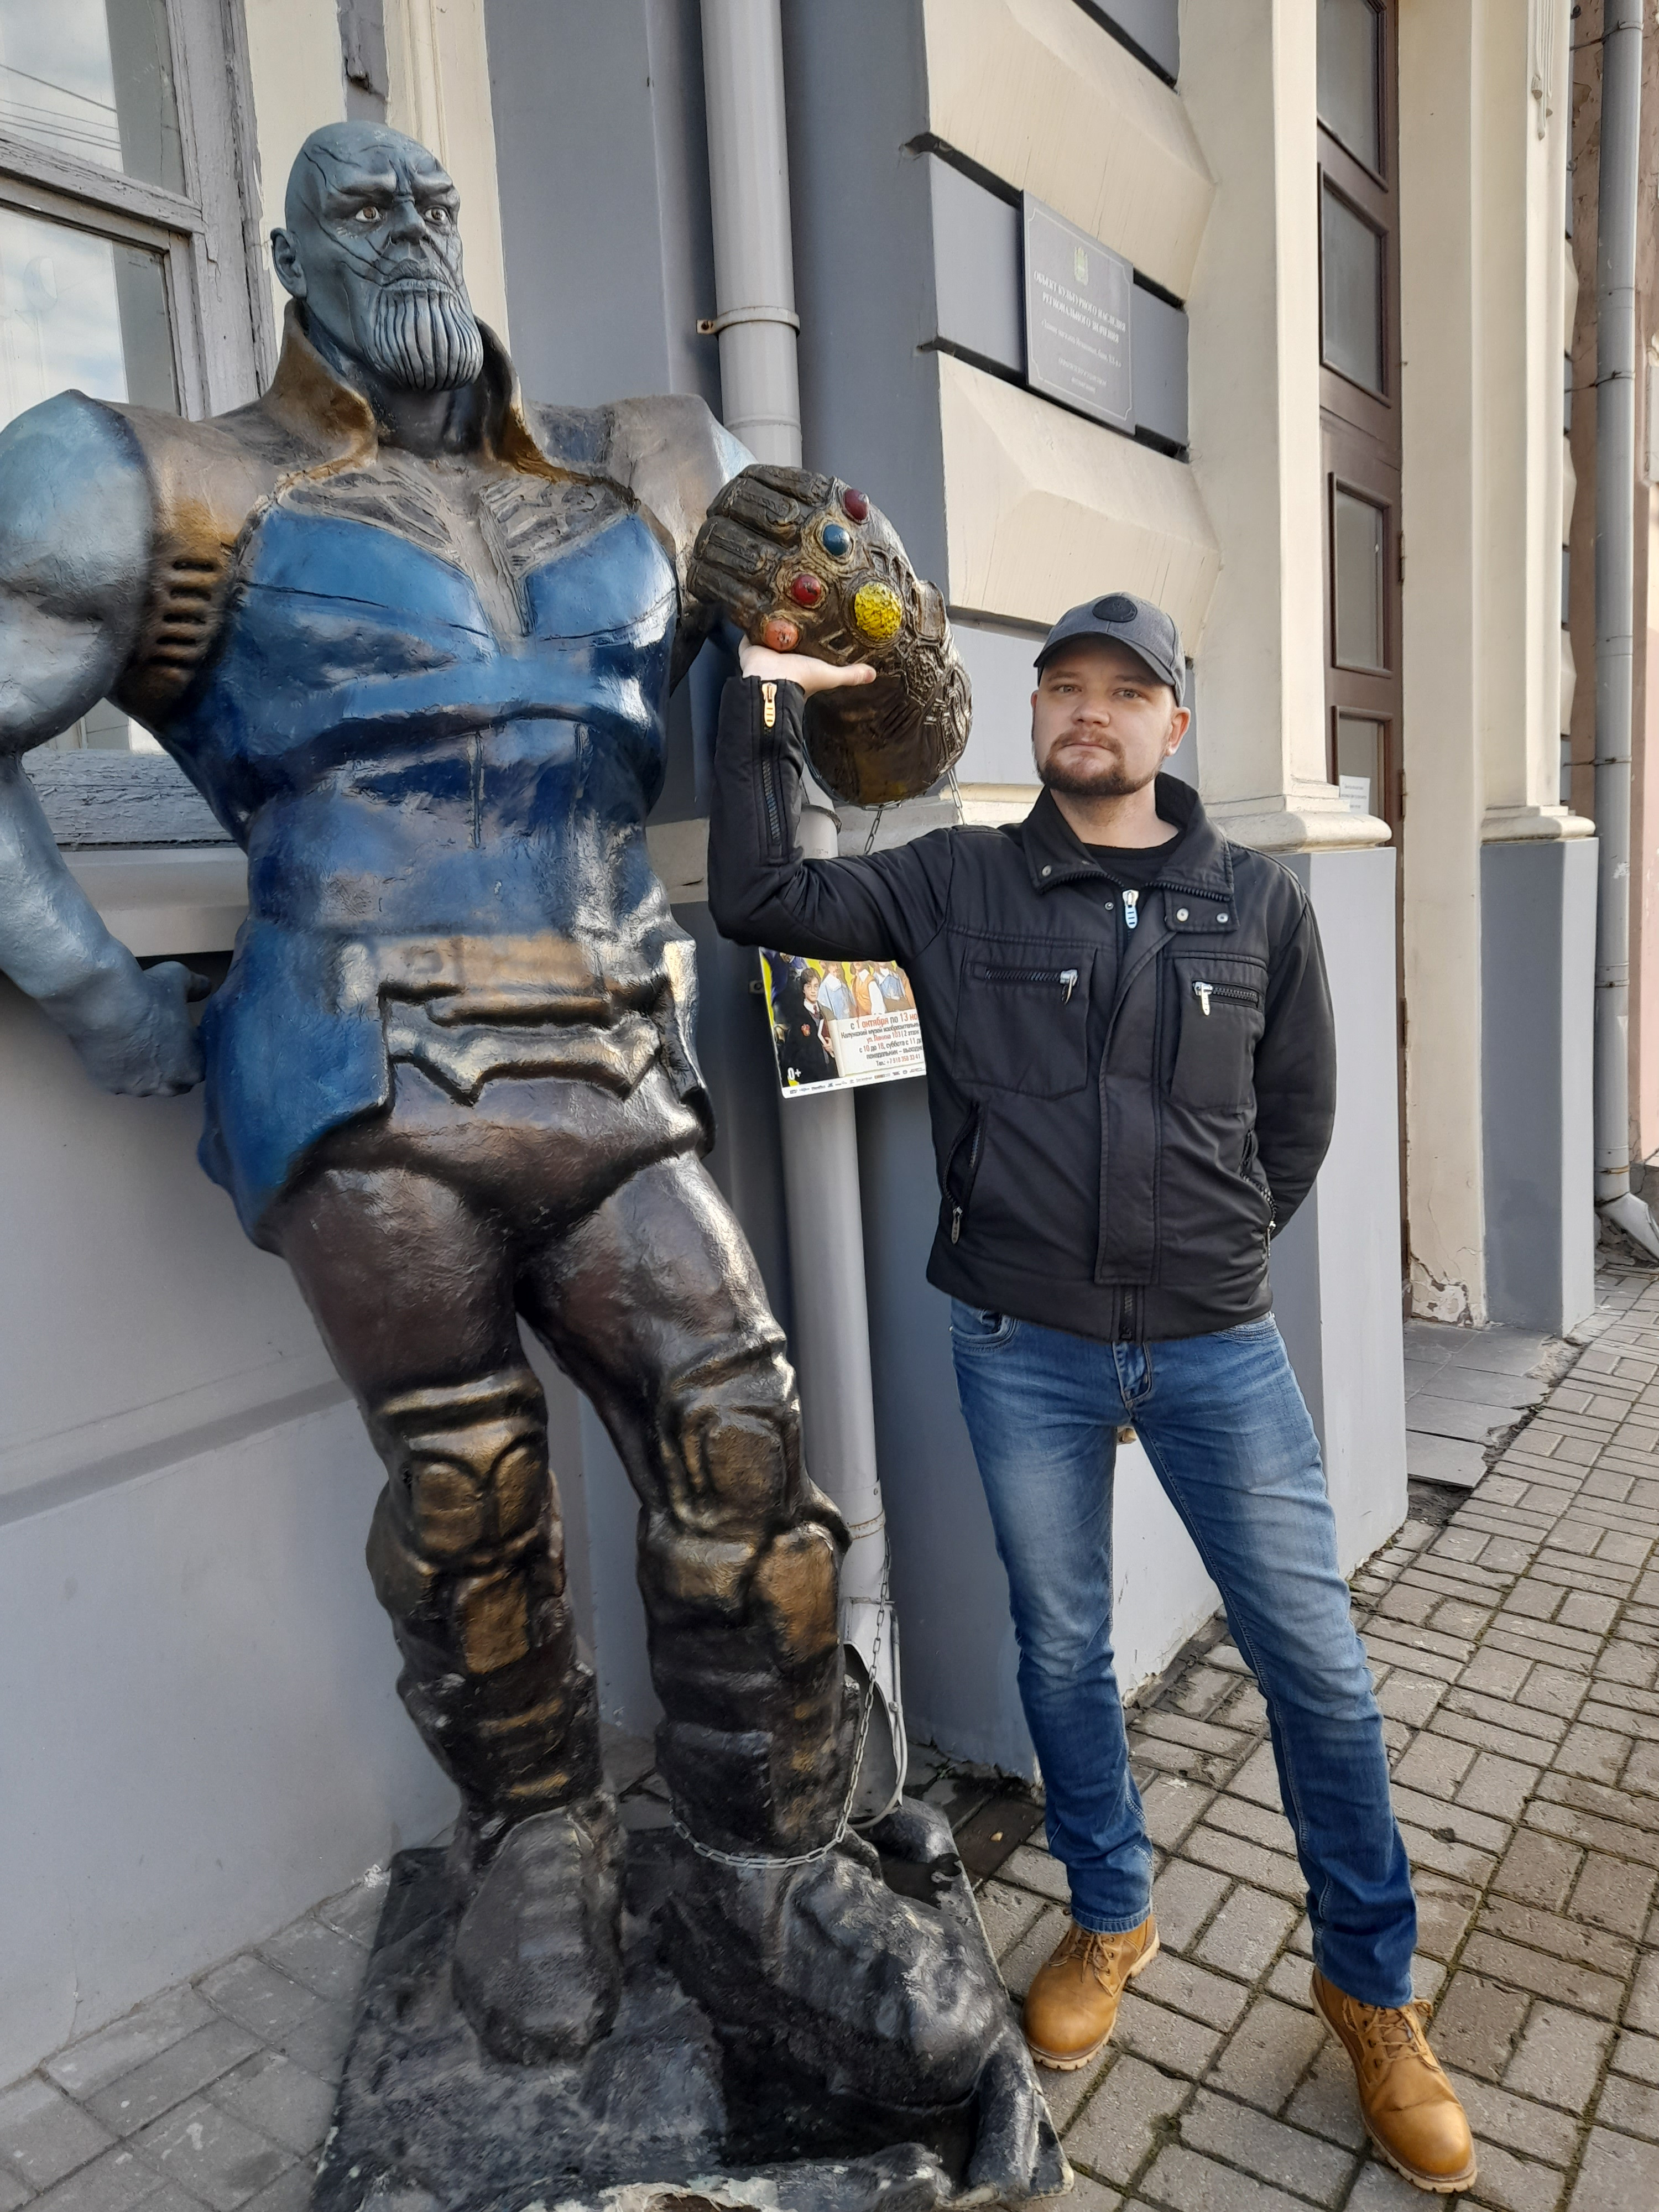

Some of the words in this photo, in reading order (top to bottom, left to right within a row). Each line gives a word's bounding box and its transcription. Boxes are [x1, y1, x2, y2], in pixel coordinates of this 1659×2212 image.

[1034, 269, 1057, 293] ОБЪЕКТ
[1058, 283, 1097, 316] КУЛЬТУРНОГО
[1098, 307, 1125, 333] НАСЛЕДИЯ
[1042, 290, 1091, 328] РЕГИОНАЛЬНОГО
[856, 1019, 860, 1029] 1
[862, 1016, 889, 1028] октября
[900, 1012, 909, 1022] 13
[886, 1040, 905, 1049] суббота
[787, 1067, 801, 1081] 0+
